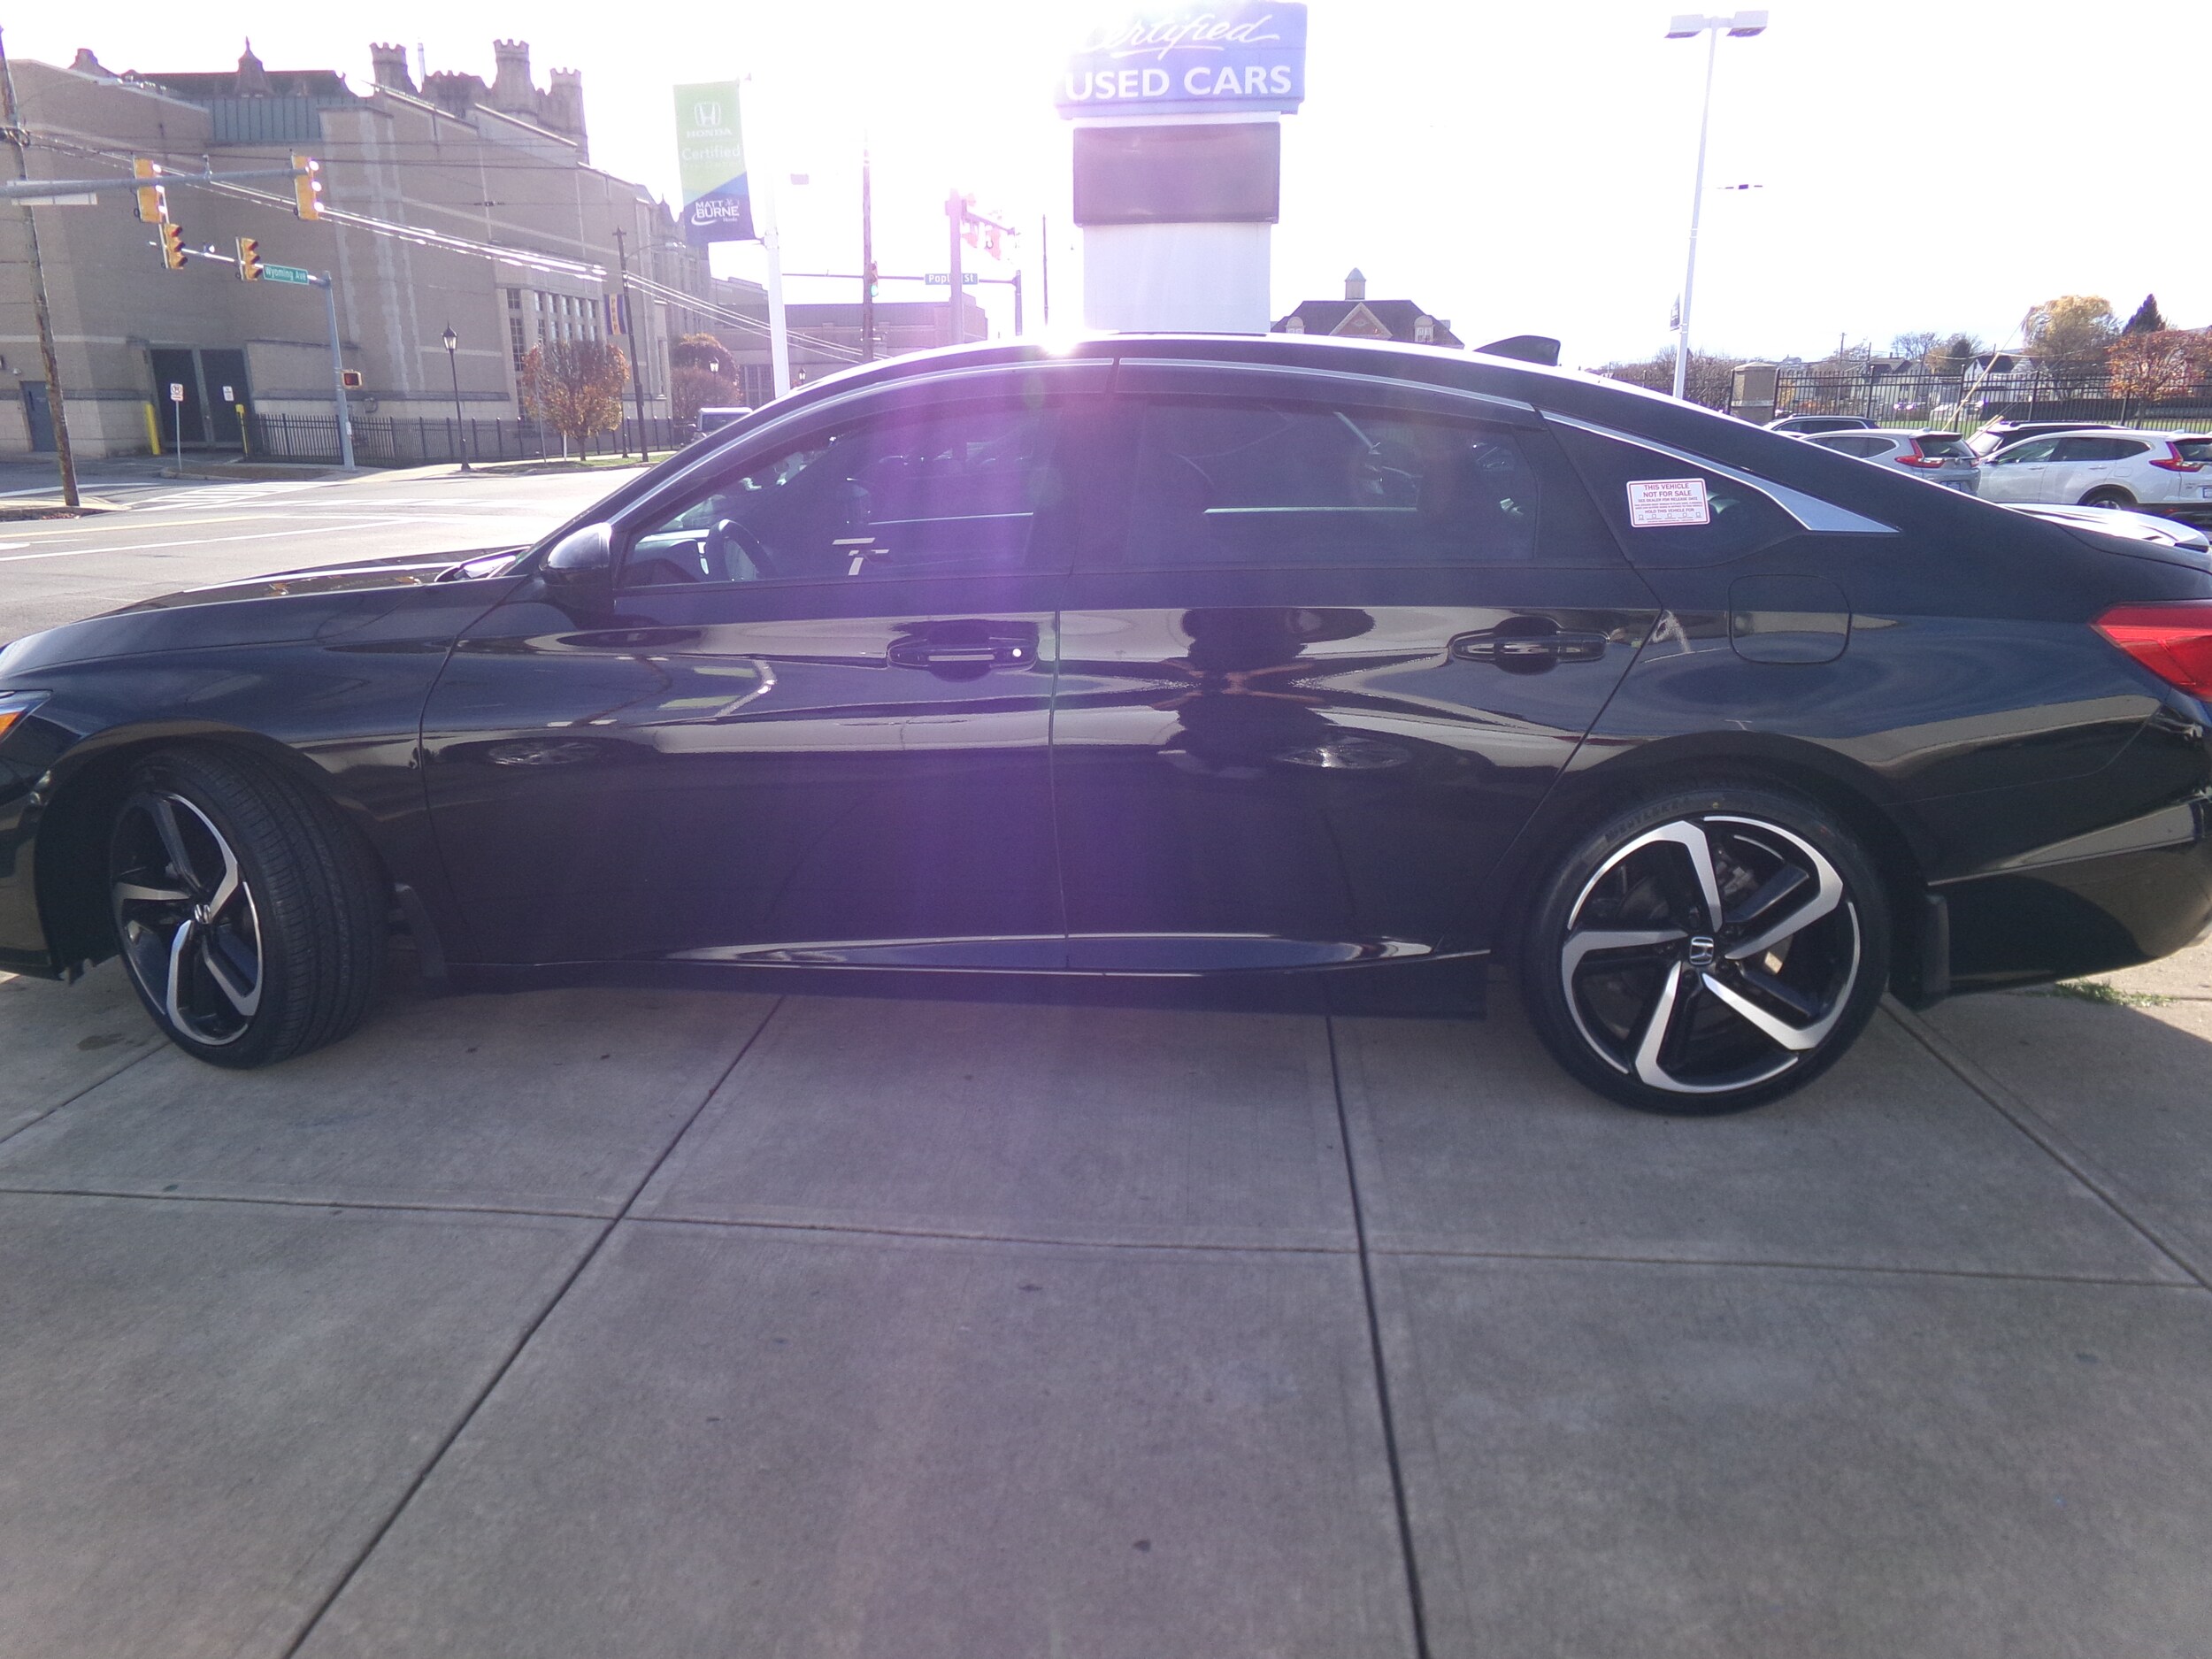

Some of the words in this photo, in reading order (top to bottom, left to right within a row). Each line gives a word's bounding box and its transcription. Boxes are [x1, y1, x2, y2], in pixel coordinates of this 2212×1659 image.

[1065, 68, 1170, 101] USED
[1183, 65, 1292, 95] CARS
[687, 127, 733, 138] HONDA
[681, 144, 741, 160] Certified
[696, 206, 740, 219] BURNE
[265, 266, 294, 281] Wyoming
[296, 270, 306, 280] Ave
[929, 274, 950, 283] Popl
